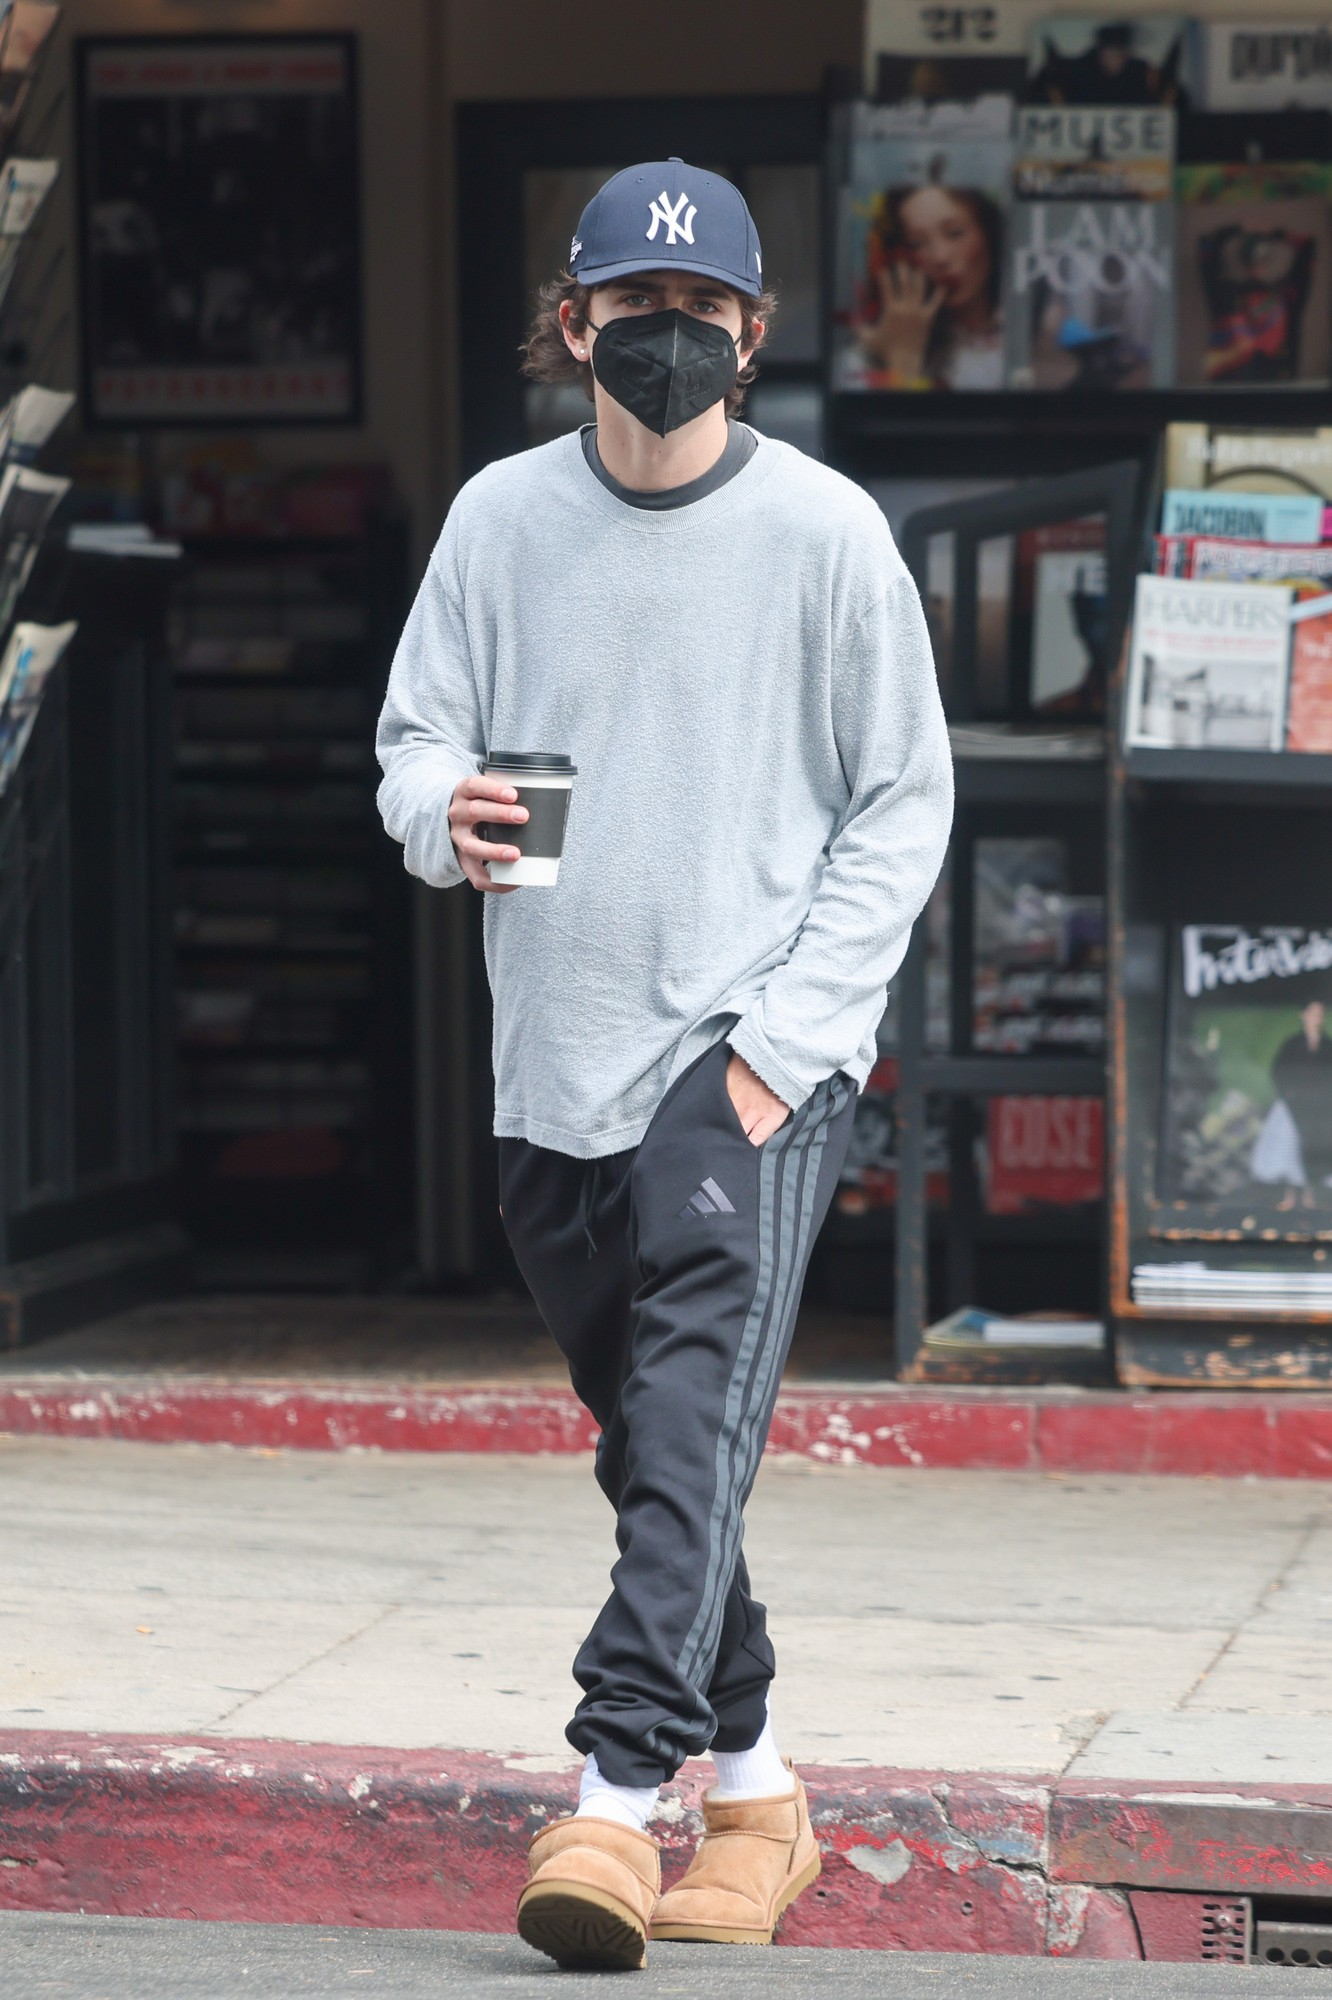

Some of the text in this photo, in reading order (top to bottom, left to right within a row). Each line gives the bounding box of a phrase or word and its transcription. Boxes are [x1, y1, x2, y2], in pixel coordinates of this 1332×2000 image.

[1023, 113, 1166, 150] MUSE
[645, 191, 697, 245] NY
[1173, 503, 1266, 539] JACOBIN
